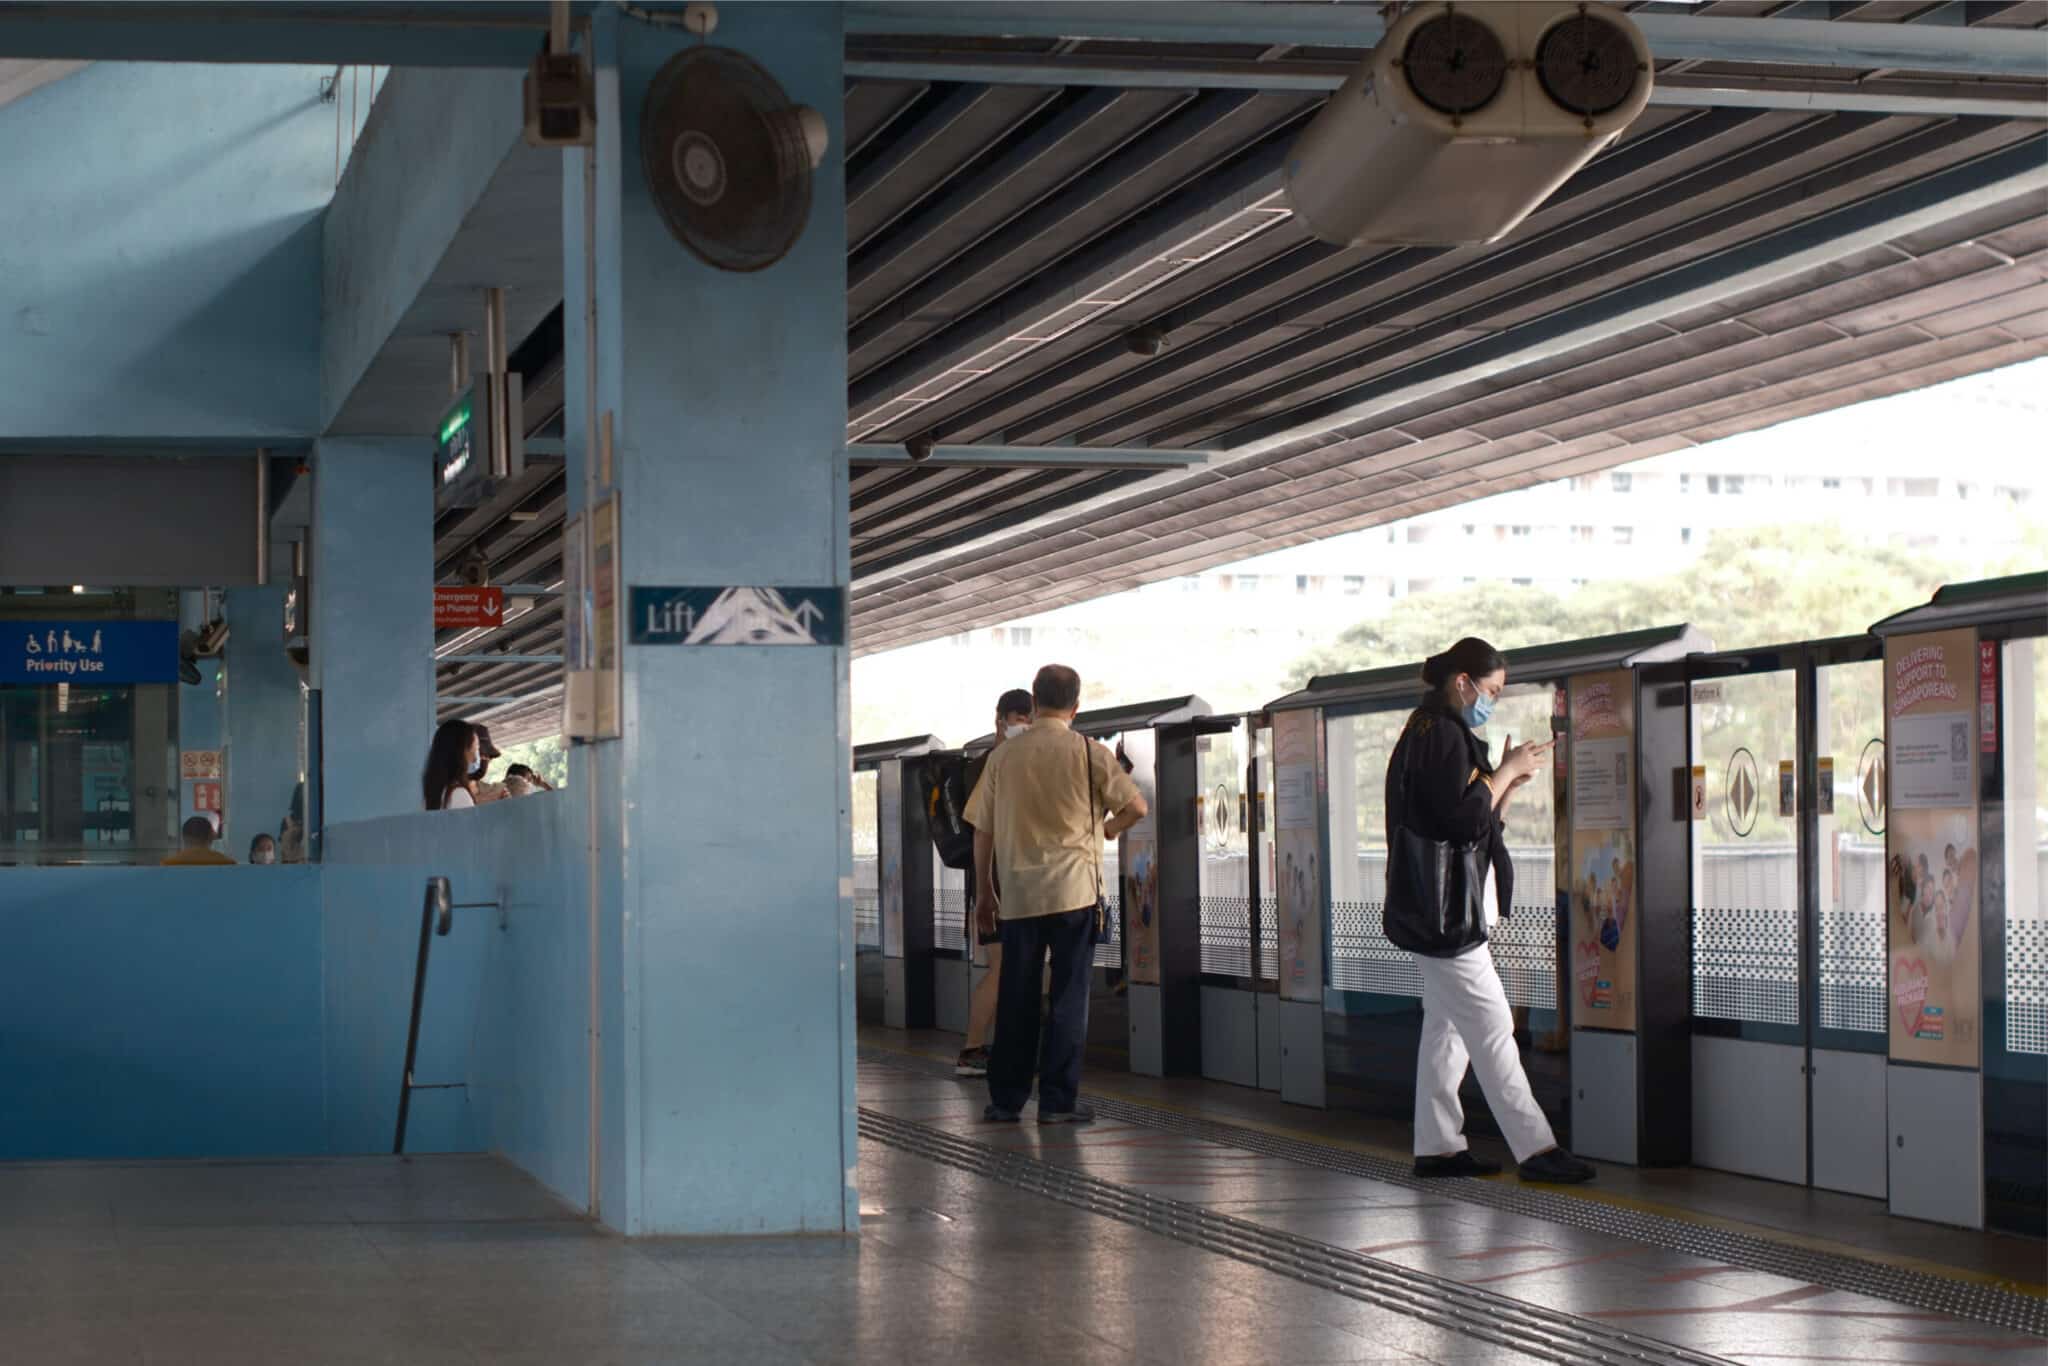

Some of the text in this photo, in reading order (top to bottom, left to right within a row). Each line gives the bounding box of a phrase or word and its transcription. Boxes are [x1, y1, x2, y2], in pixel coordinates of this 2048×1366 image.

[648, 600, 696, 632] Lift
[80, 659, 104, 671] Use
[1896, 645, 1943, 675] DELIVERING
[1896, 663, 1947, 692] SUPPORT TO
[1893, 682, 1957, 716] SINGAPOREANS
